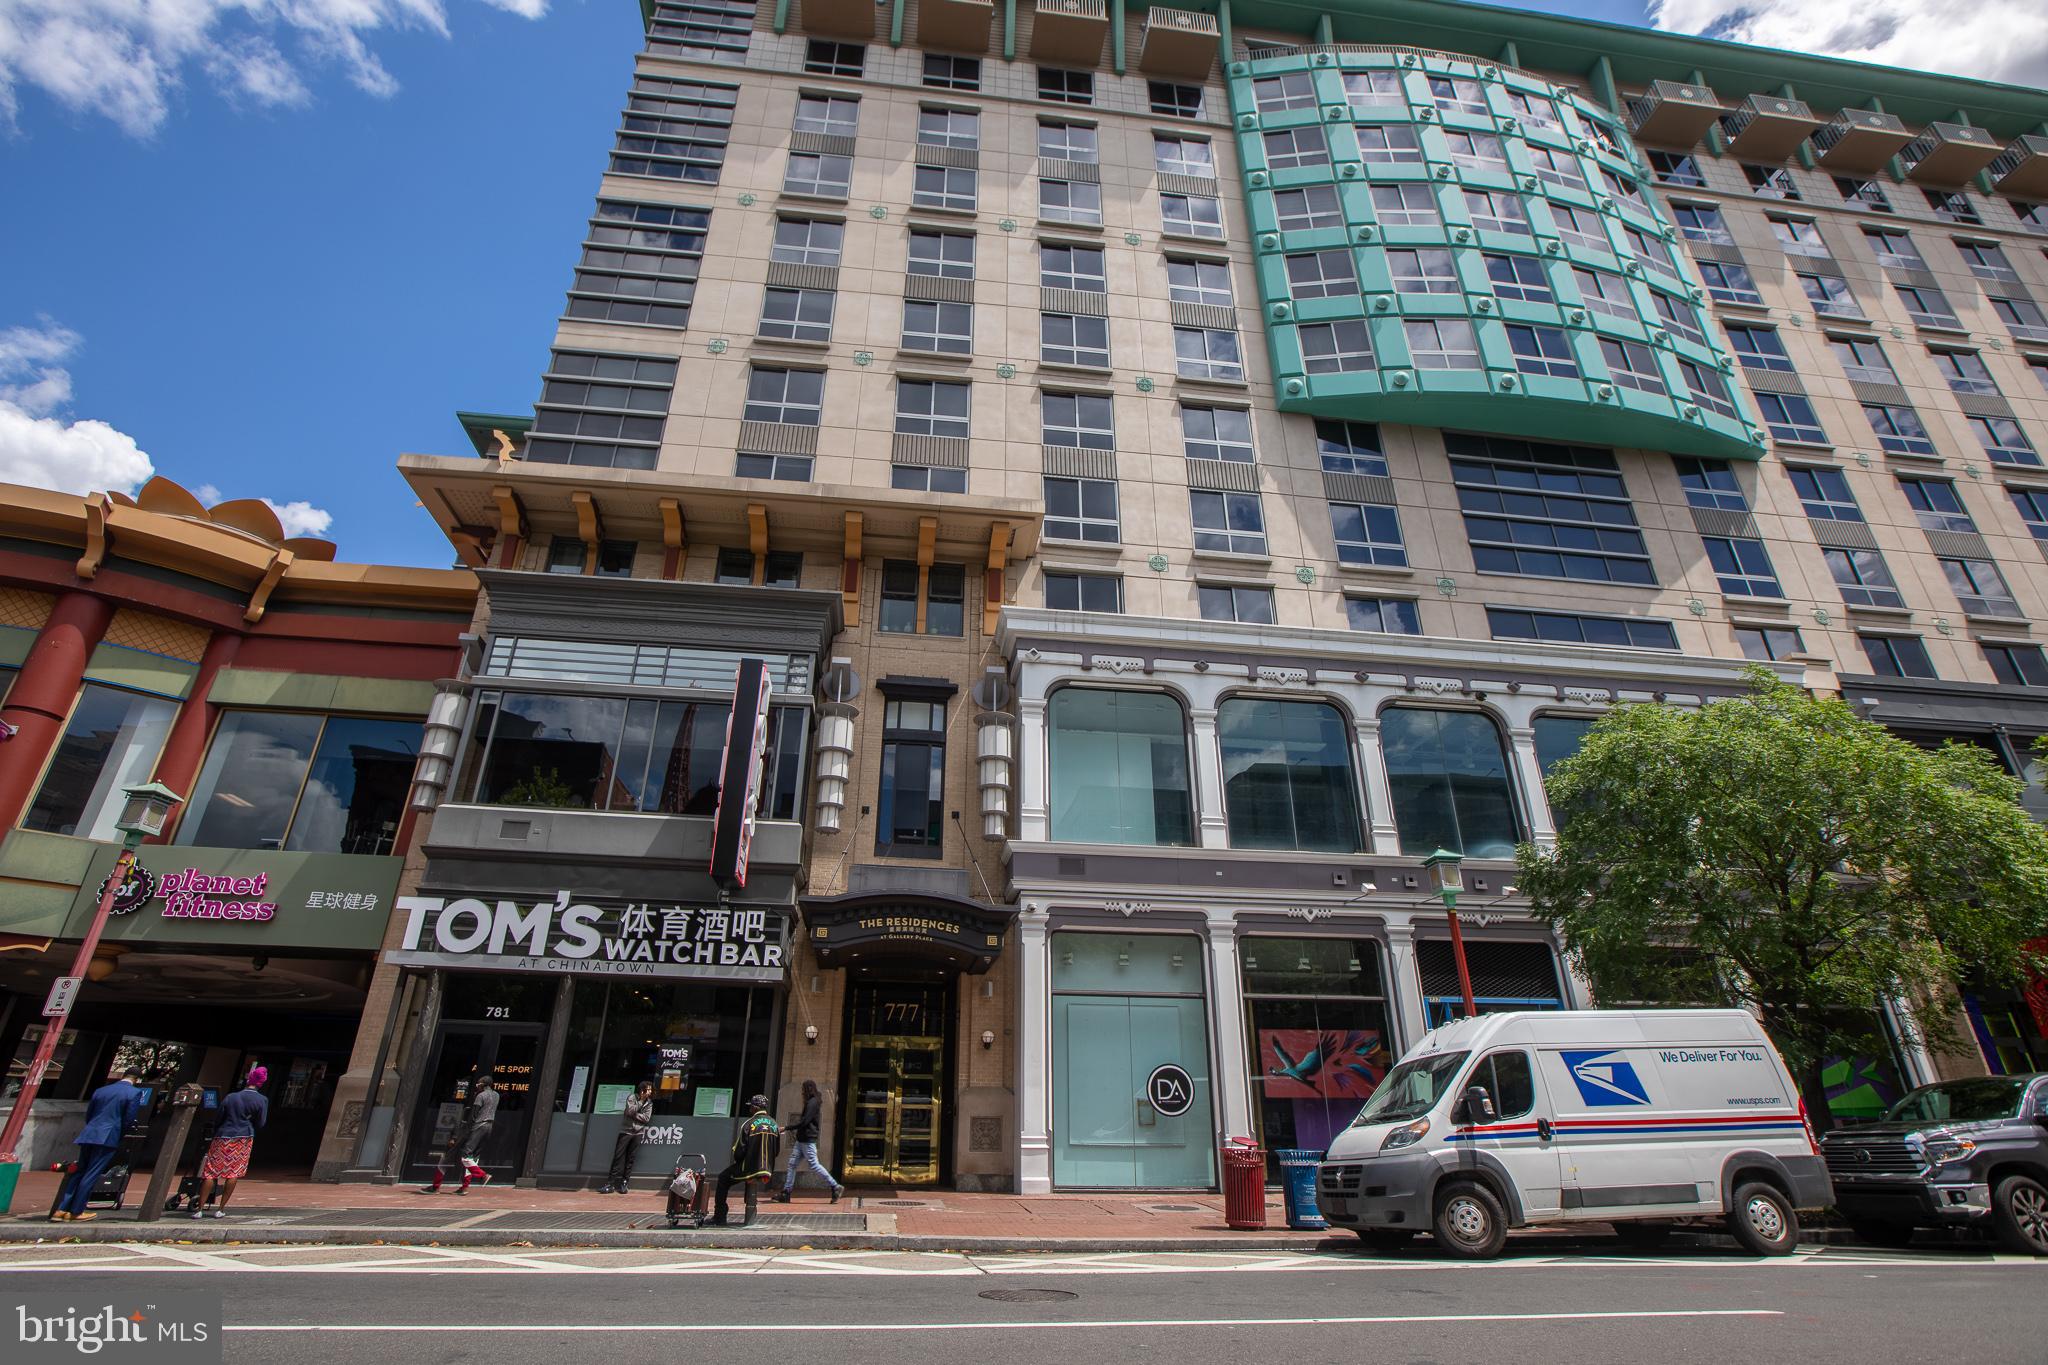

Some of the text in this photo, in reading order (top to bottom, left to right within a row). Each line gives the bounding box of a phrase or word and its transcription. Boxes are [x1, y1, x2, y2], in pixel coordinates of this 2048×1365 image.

[154, 868, 267, 898] planet
[161, 892, 279, 920] fitness
[305, 891, 379, 911] 星球健身
[396, 890, 605, 959] TOM'S
[620, 903, 766, 943] 体育酒吧
[859, 919, 883, 929] THE
[886, 918, 960, 934] RESIDENCES
[605, 937, 784, 967] WATCH BAR
[517, 957, 656, 975] AT CHINATOWN
[486, 1007, 510, 1018] 781
[884, 1003, 919, 1021] 777
[662, 1048, 688, 1058] TOM'S
[1659, 1050, 1762, 1063] We Deliver For You.
[507, 1065, 534, 1074] SPOR
[494, 1083, 530, 1091] THE TIME
[1157, 1079, 1186, 1100] DA
[1726, 1097, 1781, 1106] www.usps.com
